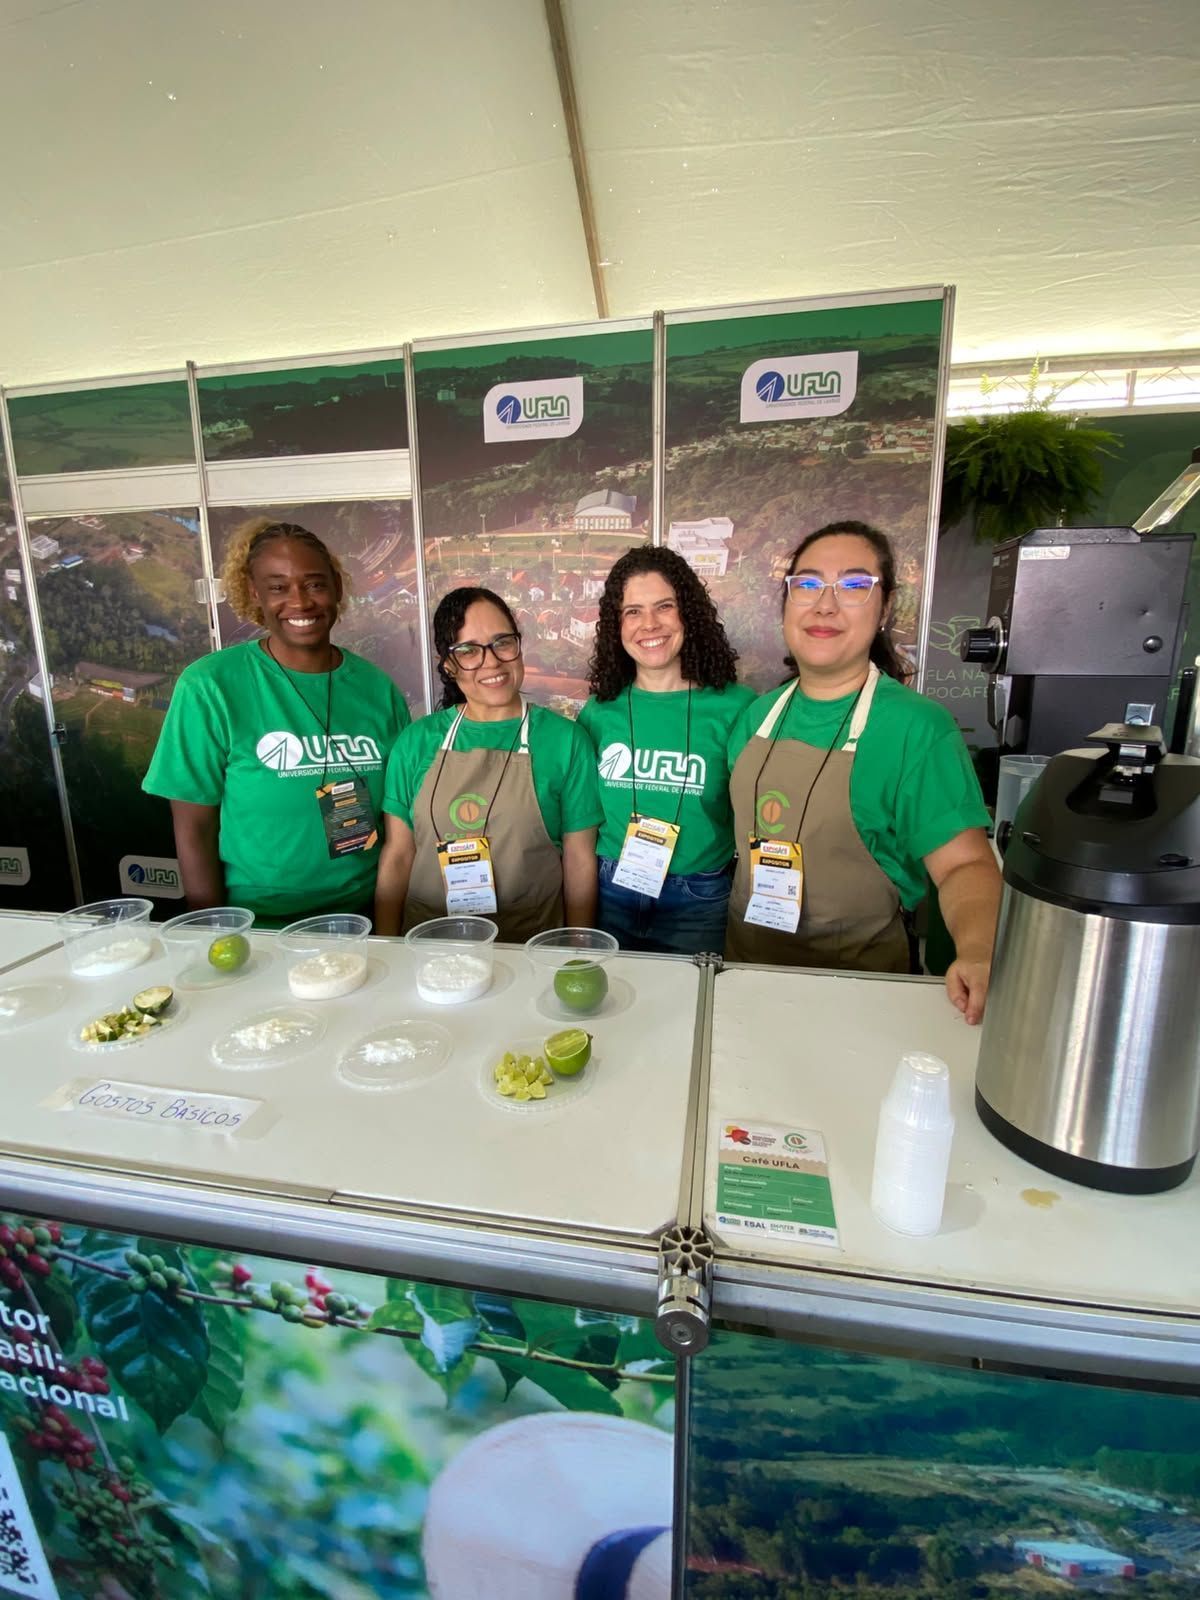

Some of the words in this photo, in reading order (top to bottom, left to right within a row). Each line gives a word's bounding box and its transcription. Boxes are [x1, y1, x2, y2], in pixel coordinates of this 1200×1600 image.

[787, 371, 841, 396] UFLA
[523, 395, 570, 419] UFLA
[302, 735, 382, 763] UFLA
[634, 749, 706, 785] UFLA
[645, 784, 670, 793] FEDERAL
[742, 1156, 770, 1166] Café
[772, 1159, 801, 1170] UFLA
[744, 1220, 767, 1230] ESAL
[0, 1301, 50, 1334] tor
[0, 1339, 67, 1373] asil:
[0, 1371, 129, 1421] acional
